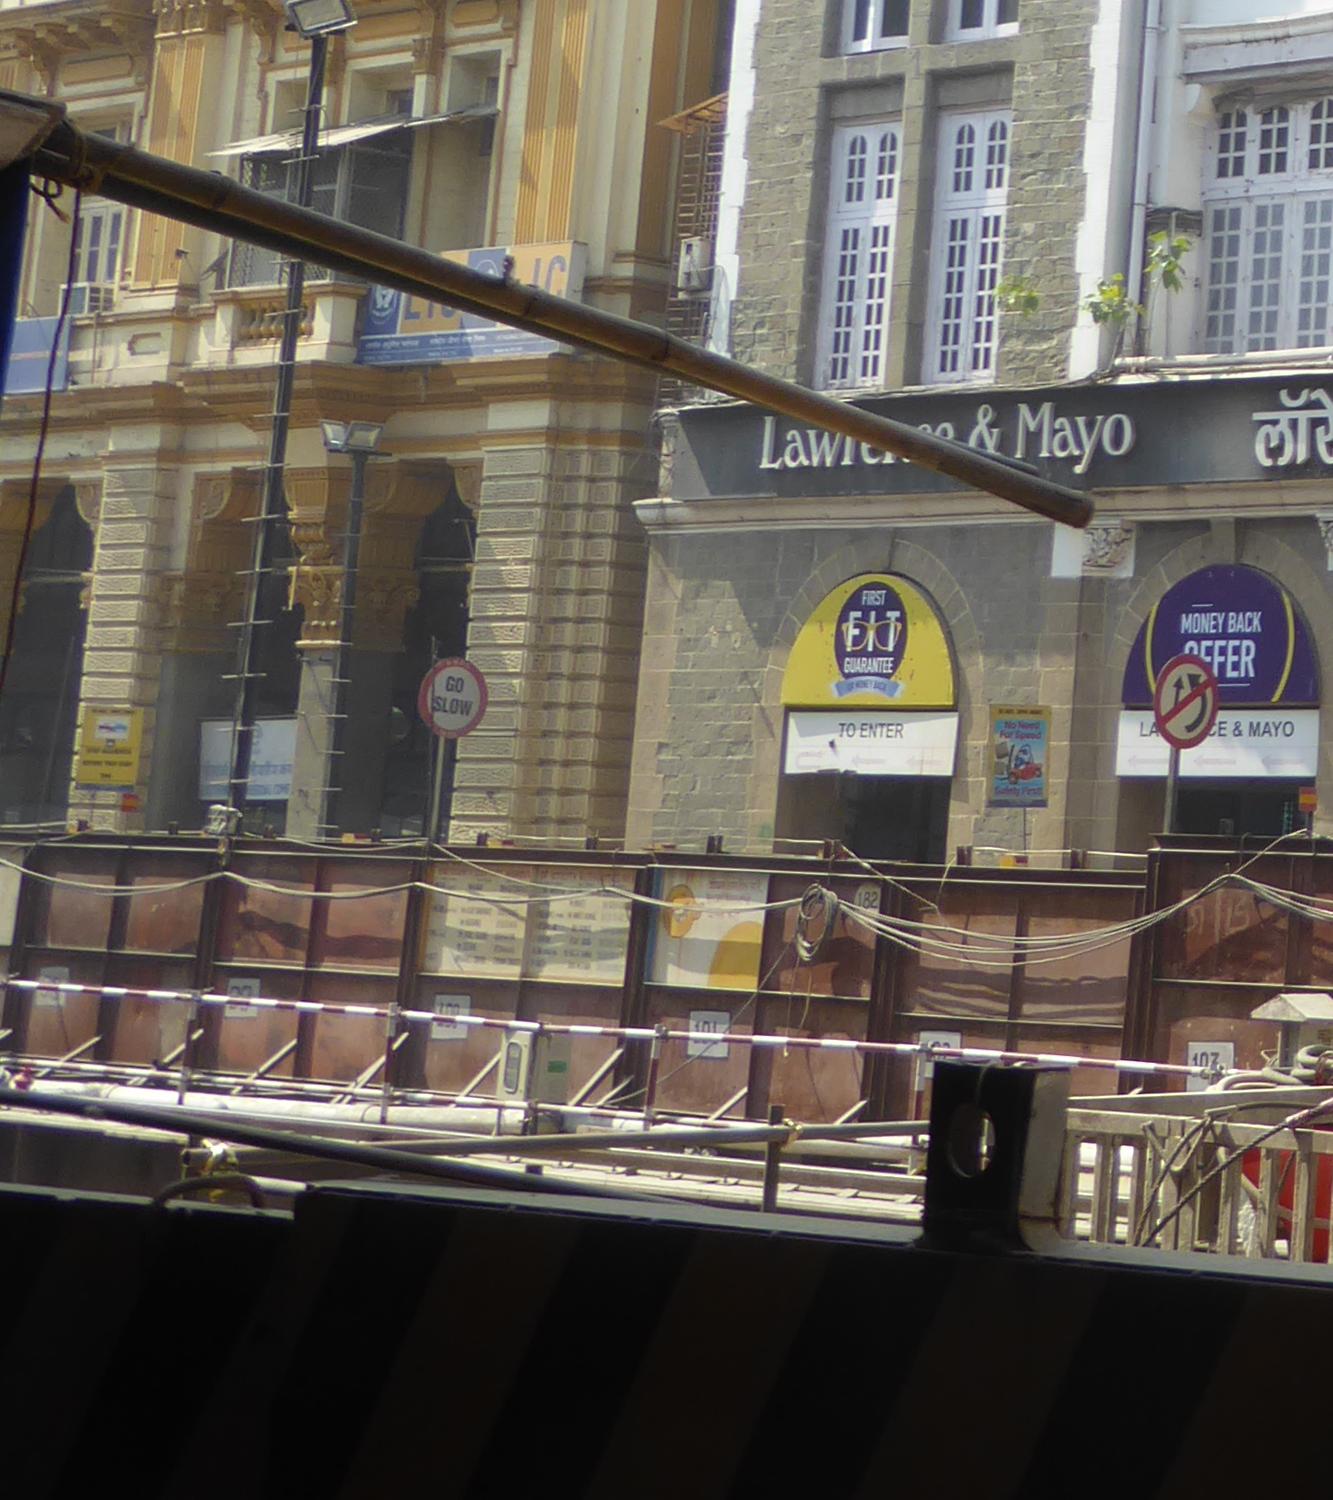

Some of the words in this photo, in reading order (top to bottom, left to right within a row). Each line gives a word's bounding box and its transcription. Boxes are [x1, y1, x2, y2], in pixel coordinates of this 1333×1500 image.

[968, 403, 1003, 454] &
[1014, 401, 1136, 475] Mayo
[861, 589, 887, 606] FIRST
[845, 609, 901, 652] FIT
[1180, 611, 1225, 634] MONEY
[1227, 610, 1263, 633] BACK
[843, 656, 895, 674] GUARANTEE
[445, 675, 465, 694] GO
[432, 696, 474, 717] SLOW
[838, 722, 857, 738] TO
[859, 722, 904, 739] ENTER
[1232, 720, 1244, 738] &
[1247, 720, 1295, 738] MAYO
